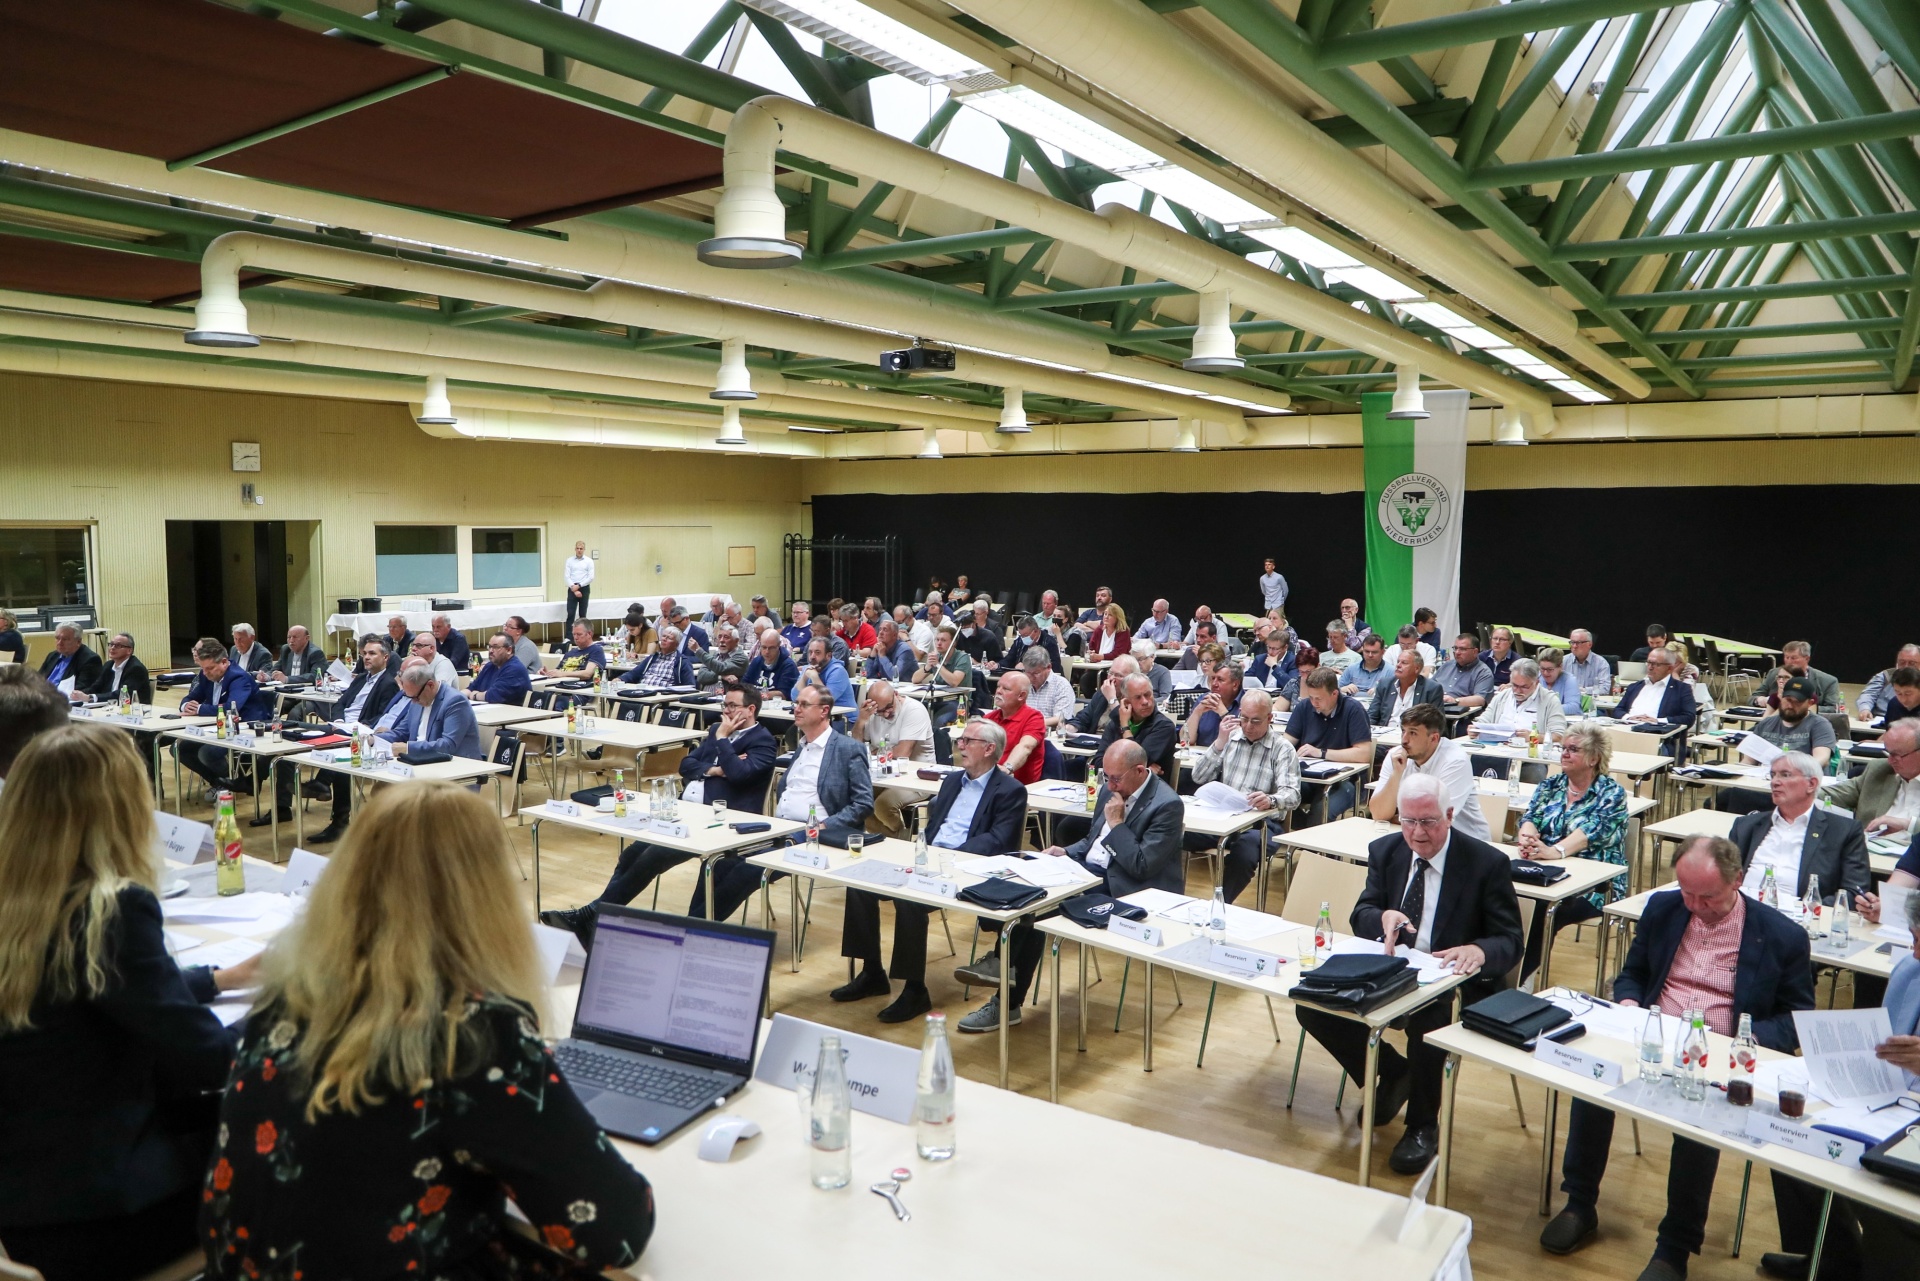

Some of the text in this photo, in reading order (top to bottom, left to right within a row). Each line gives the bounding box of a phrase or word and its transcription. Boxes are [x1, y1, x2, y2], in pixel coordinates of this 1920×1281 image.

[1381, 475, 1447, 504] FUSSBALLVERBAND
[1384, 525, 1442, 544] NIEDERRHEIN
[1119, 921, 1137, 932] Reserviert
[1224, 951, 1247, 962] Reserviert
[1554, 1048, 1582, 1063] Reserviert
[1769, 1121, 1809, 1141] Reserviert
